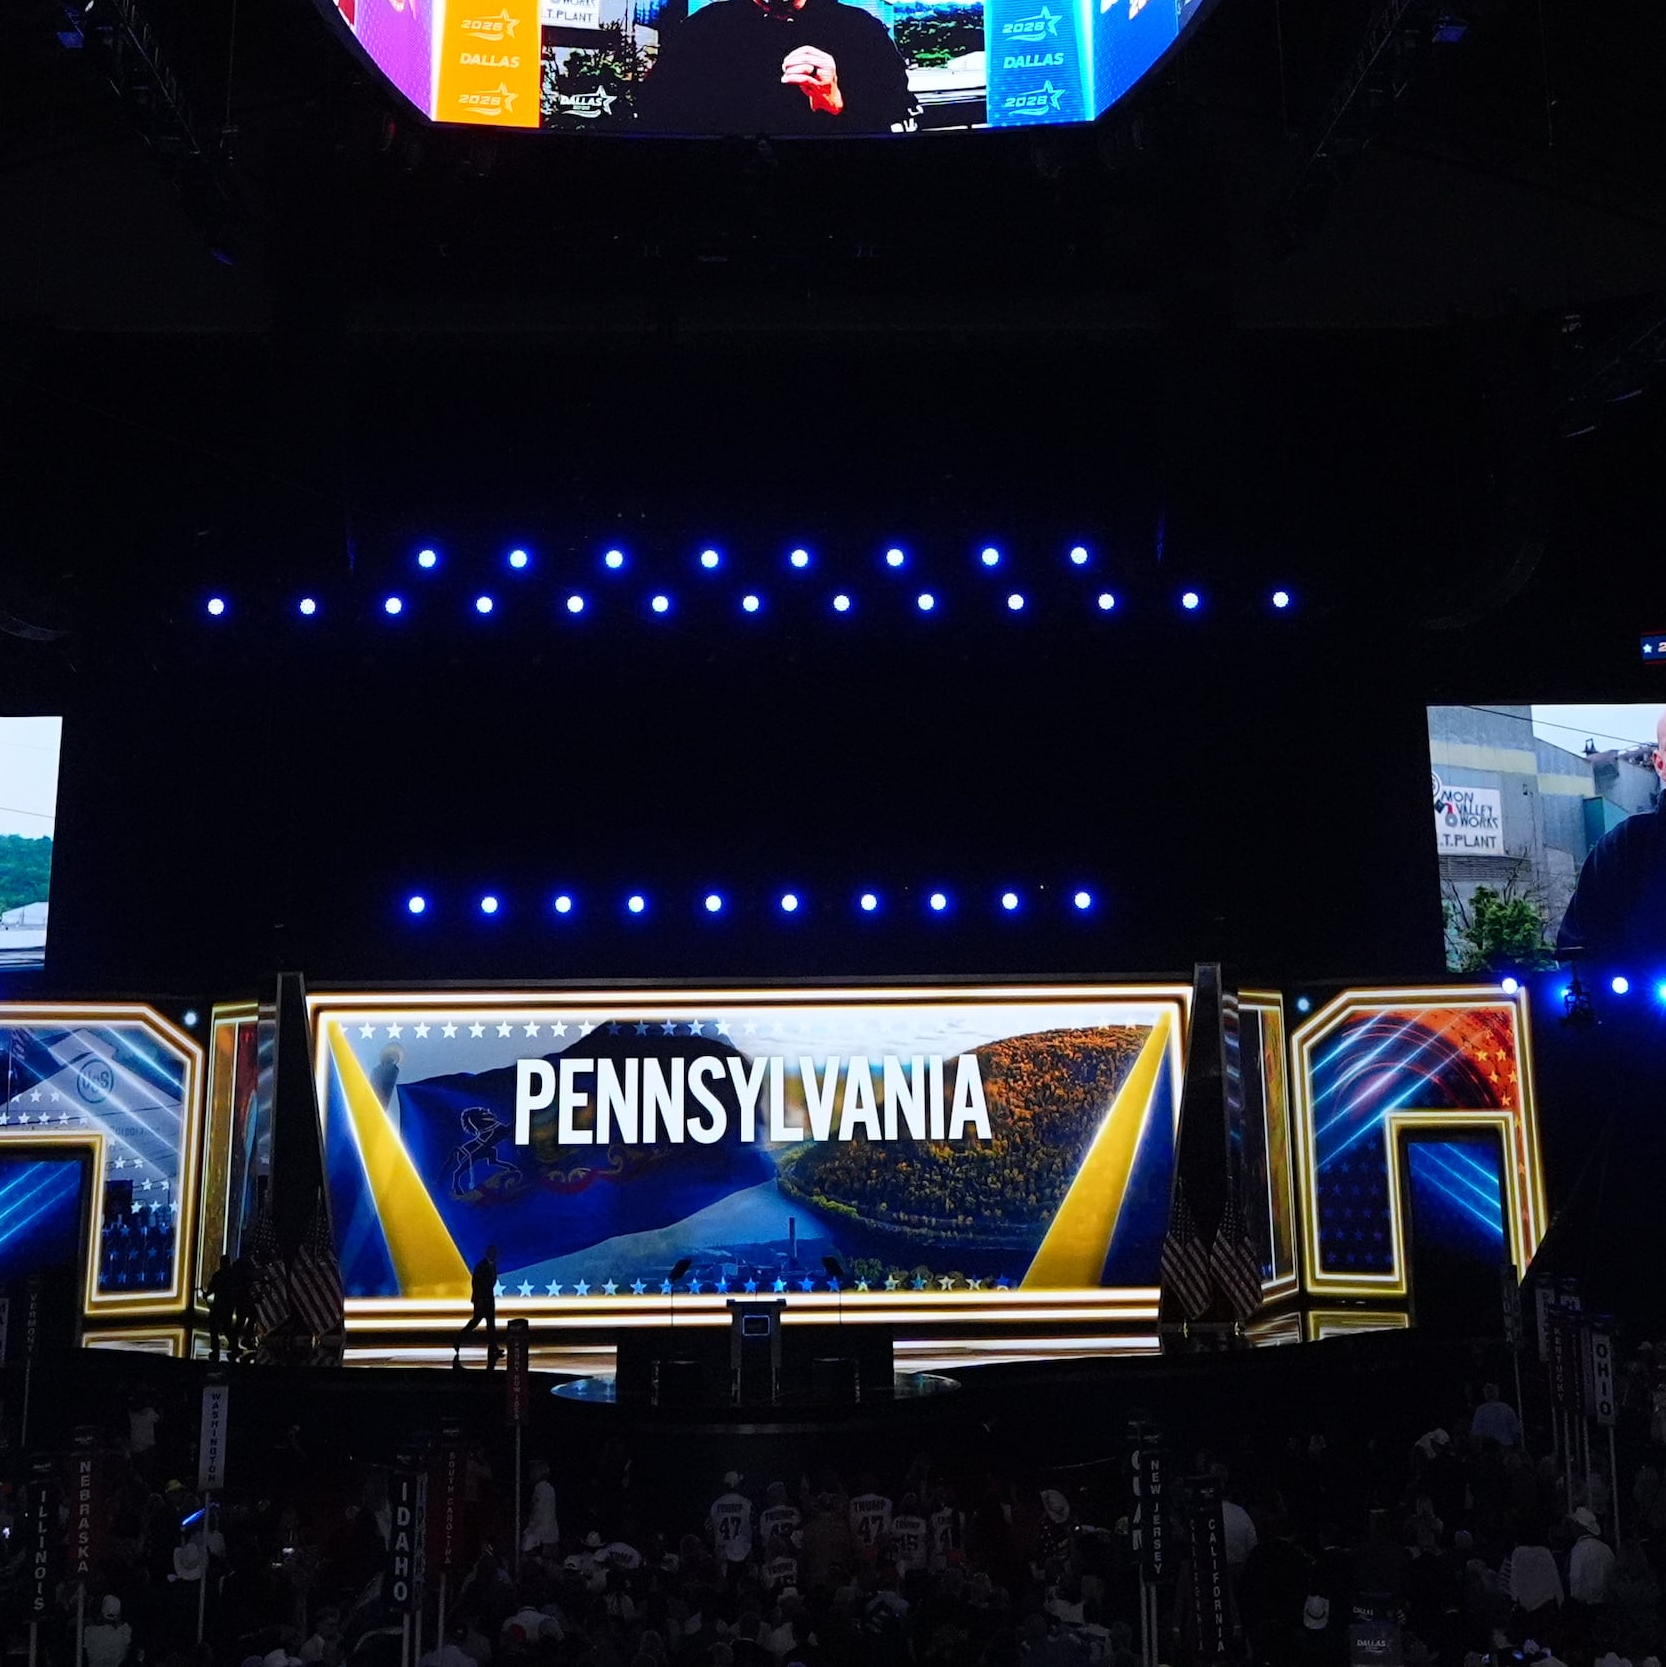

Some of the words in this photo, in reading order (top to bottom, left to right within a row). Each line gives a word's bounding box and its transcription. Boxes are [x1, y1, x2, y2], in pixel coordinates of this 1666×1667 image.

[460, 53, 520, 68] DALLAS
[1003, 53, 1064, 69] DALLAS
[560, 94, 603, 106] DALLAS
[1441, 790, 1474, 803] MON
[1455, 803, 1493, 817] VALLEY
[1460, 816, 1499, 829] WORKS
[515, 1052, 992, 1145] PENNSYLVANIA
[27, 1293, 38, 1352] VERMONT
[1553, 1326, 1565, 1403] KENTUCKY
[1596, 1343, 1612, 1416] OHIO
[208, 1393, 221, 1483] WASHINGTON
[1150, 1459, 1162, 1495] NEW
[77, 1460, 92, 1574] NEBRASKA
[854, 1501, 886, 1512] TRUMP
[393, 1481, 411, 1602] IDAHO
[719, 1516, 741, 1541] 47
[859, 1516, 884, 1544] 47
[1152, 1501, 1163, 1575] JERSEY
[32, 1489, 48, 1611] ILLINOIS
[1208, 1517, 1226, 1653] CALIFORNIA
[1356, 1639, 1386, 1647] DALLAS
